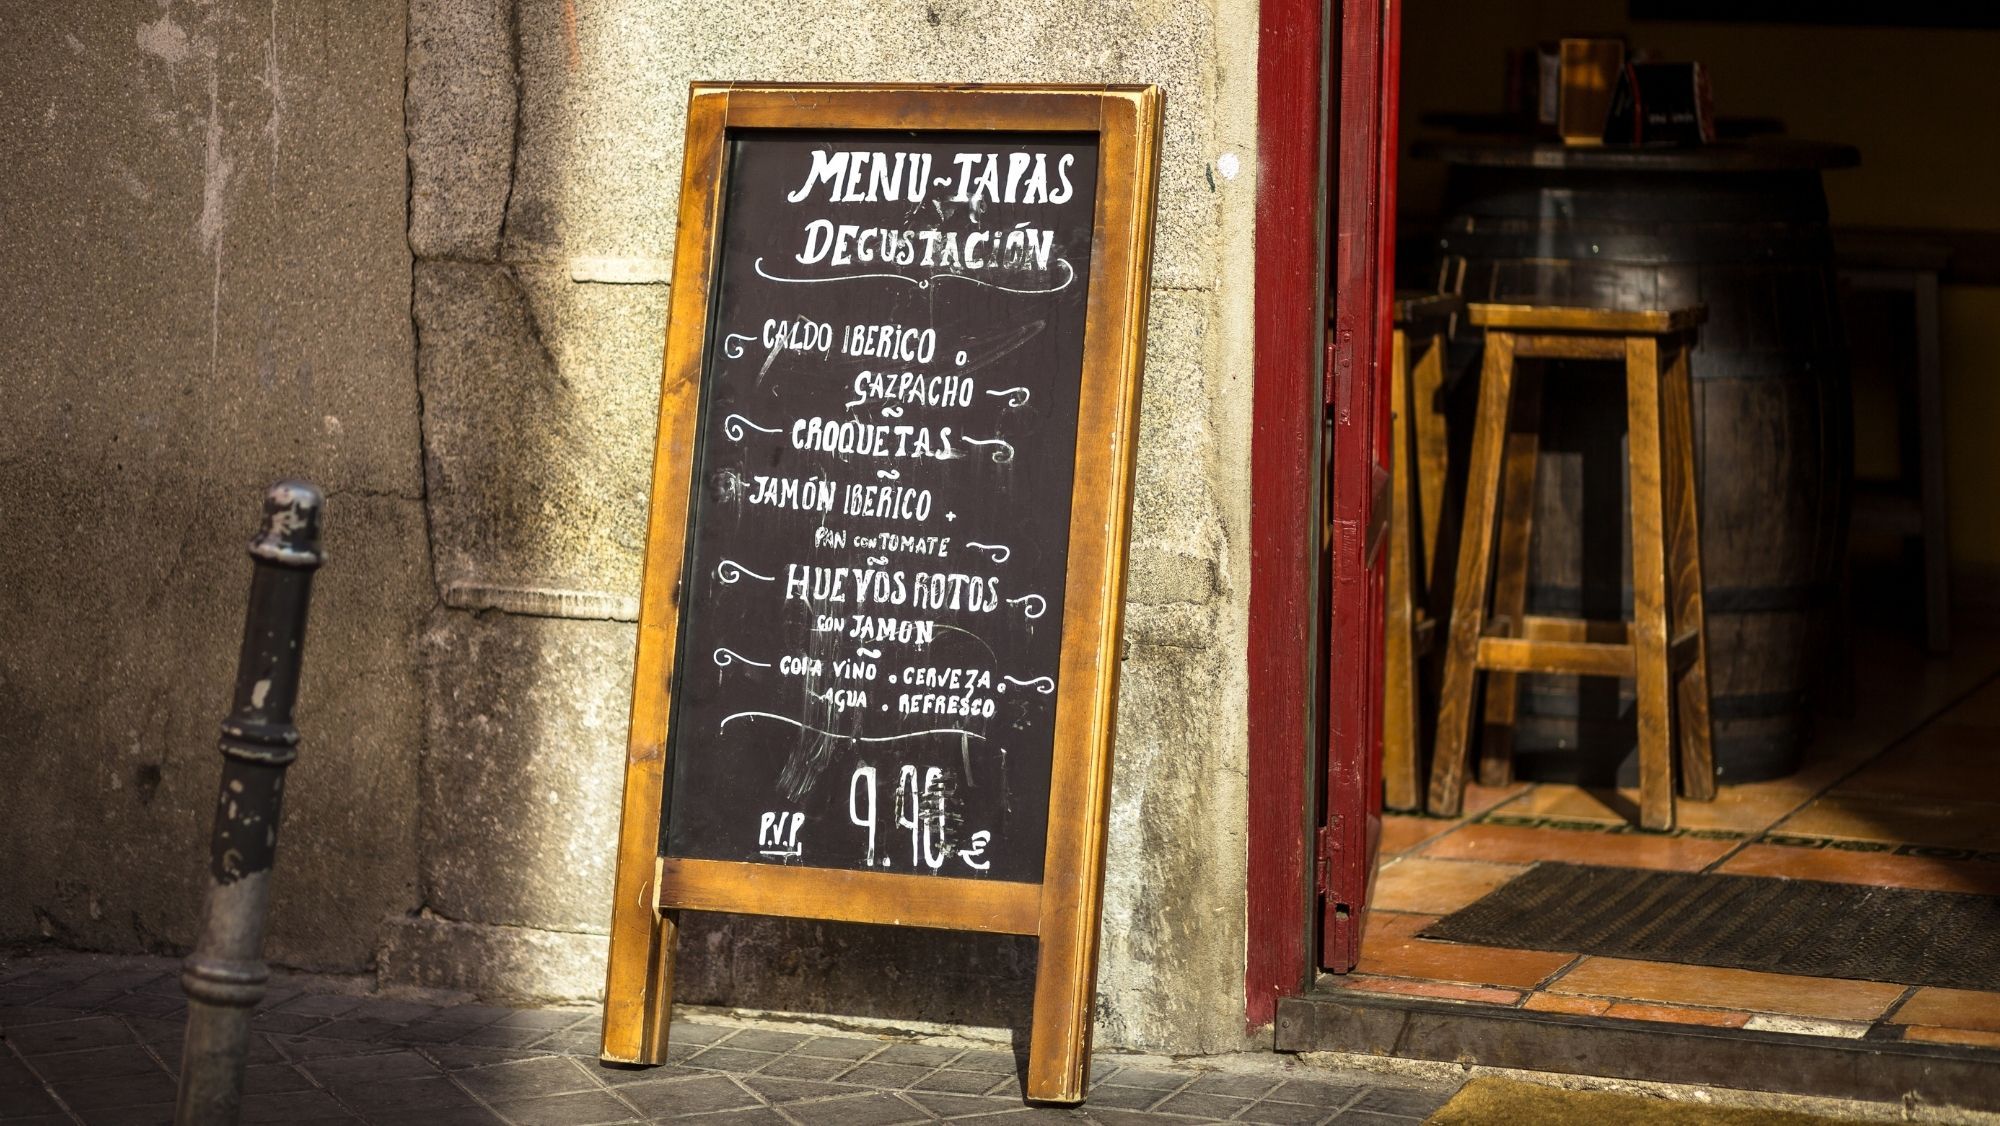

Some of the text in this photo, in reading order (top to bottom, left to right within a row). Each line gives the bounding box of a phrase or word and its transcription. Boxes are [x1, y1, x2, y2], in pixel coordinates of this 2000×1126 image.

[762, 319, 833, 352] CALDO
[846, 370, 975, 408] GAZPACHO
[792, 417, 953, 460] CROQUETAS
[749, 475, 837, 513] JAMÓN
[843, 483, 932, 521] IBERICO
[814, 526, 847, 549] PAN
[878, 532, 951, 557] TOMATE
[786, 563, 999, 613] HUEVOS ROTOS
[849, 614, 935, 645] JAMON
[903, 666, 991, 699] CERVEZA
[823, 687, 868, 713] AGUA
[898, 693, 995, 718] REFRESCO
